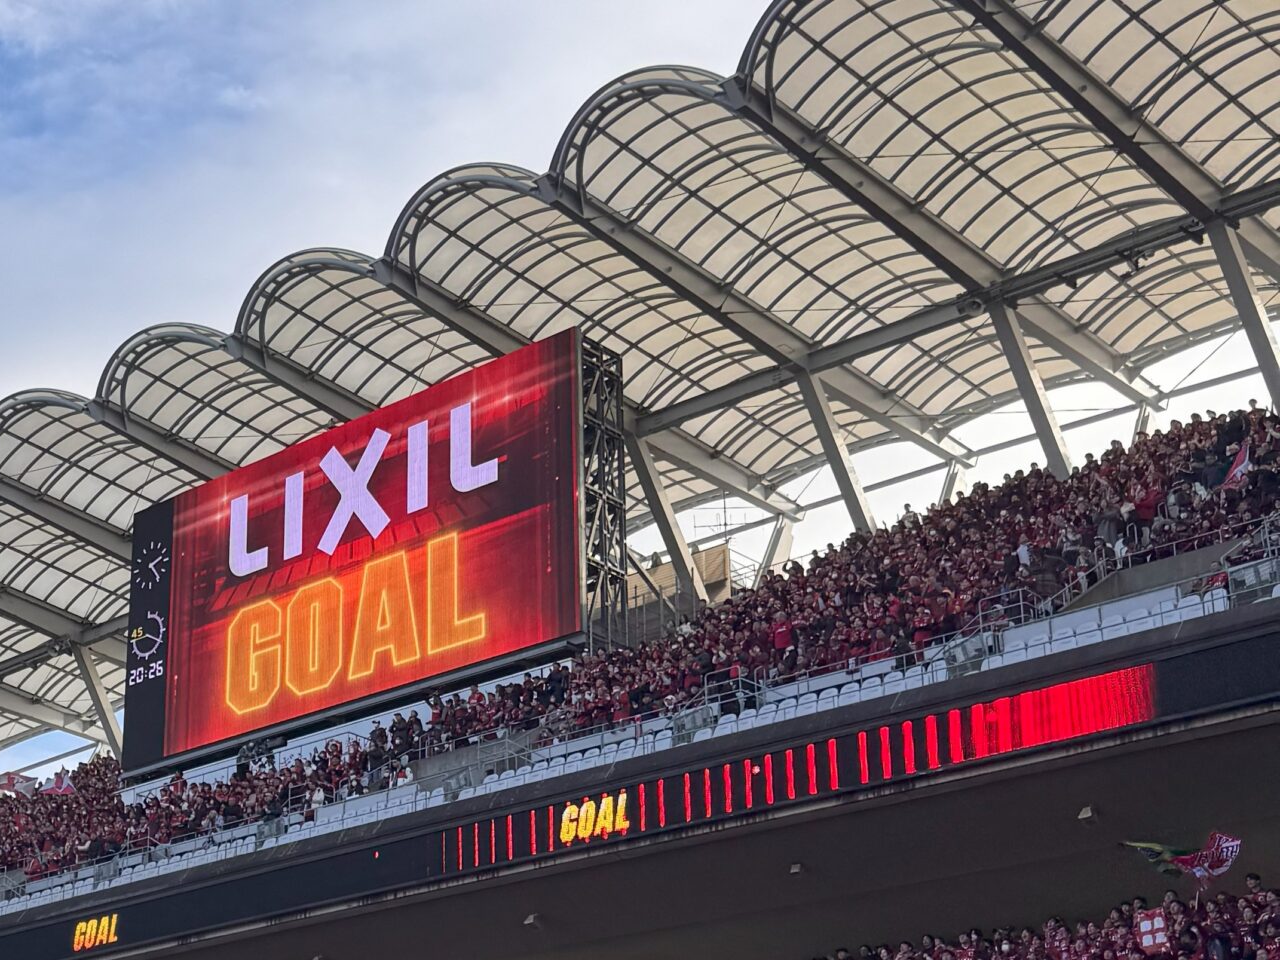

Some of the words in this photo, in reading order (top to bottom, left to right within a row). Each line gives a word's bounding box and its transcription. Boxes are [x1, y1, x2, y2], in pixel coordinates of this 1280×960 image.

[229, 402, 498, 577] LIXIL
[131, 627, 143, 638] 45
[225, 531, 487, 716] GOAL
[129, 660, 163, 686] 20:26
[560, 793, 629, 841] GOAL
[73, 914, 117, 952] GOAL
